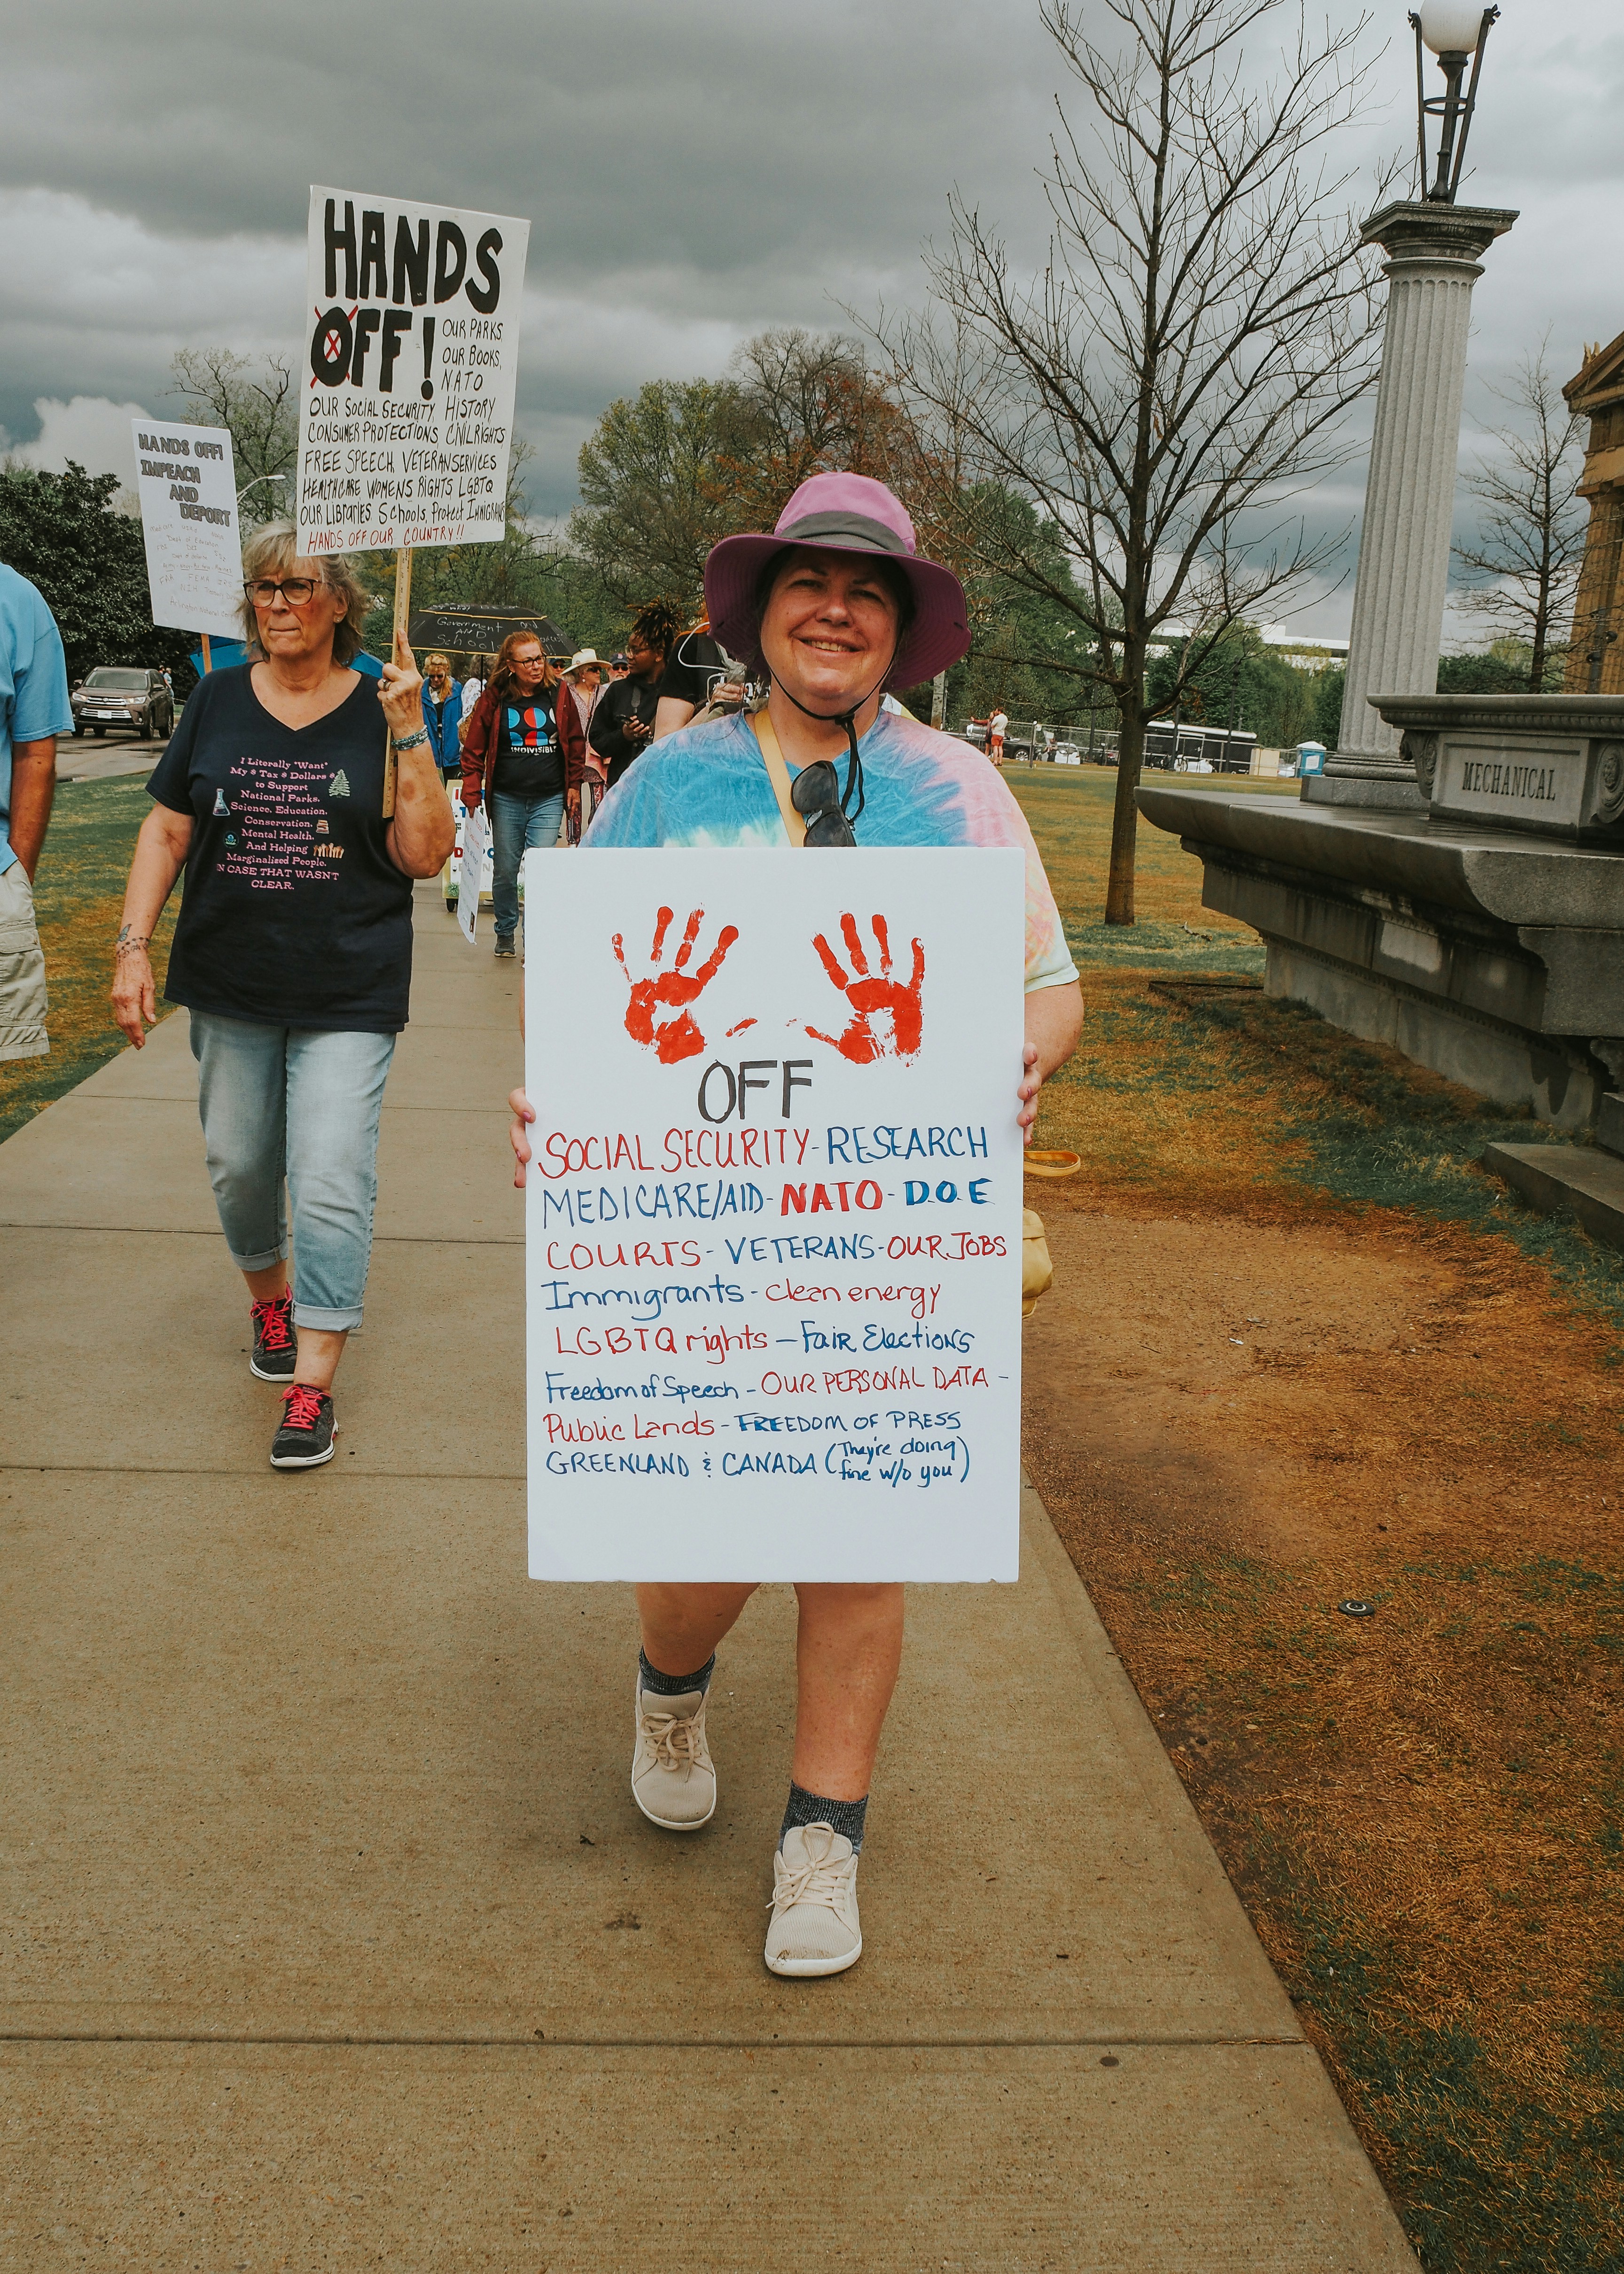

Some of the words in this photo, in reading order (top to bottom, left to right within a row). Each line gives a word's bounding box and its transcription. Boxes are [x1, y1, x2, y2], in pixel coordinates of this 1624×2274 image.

[325, 198, 503, 314] HANDS
[443, 319, 466, 339] OUR
[443, 347, 464, 366] OUR
[310, 396, 338, 417] OUR
[345, 397, 378, 417] SOCIAL
[308, 421, 359, 443] CONSUMER
[139, 433, 189, 455] HANDS
[194, 441, 224, 460] OFF!
[141, 460, 201, 483] IMPEACH
[305, 450, 341, 475] FREE
[170, 485, 198, 502] AND
[367, 478, 413, 500] WOMENS
[459, 476, 493, 498] LGBTQ
[180, 503, 230, 527] DEPORT
[300, 503, 322, 526] OUR
[431, 500, 464, 524] Protect
[308, 530, 344, 554] HANDS
[349, 529, 367, 547] OFF
[370, 527, 393, 545] OUR
[404, 525, 464, 545] COUNTRY!!
[188, 573, 209, 582] FEMA
[218, 579, 232, 588] IRS
[230, 767, 248, 776] My
[259, 769, 279, 778] Tax
[247, 757, 291, 770] Literally
[267, 780, 308, 792] Support
[1462, 761, 1556, 801] MECHANICAL
[240, 789, 285, 802] National
[241, 828, 276, 839] Mental
[246, 841, 266, 851] And
[270, 843, 308, 855] Helping
[227, 865, 258, 876] CASE
[260, 868, 292, 877] THAT
[251, 879, 295, 890] CLEAR.
[698, 1059, 813, 1124] OFF
[538, 1132, 654, 1179] SOCIAL
[828, 1126, 988, 1164] RESEARCH
[781, 1179, 883, 1216] NATO
[887, 1235, 947, 1260] OUR
[946, 1231, 1007, 1260] JOBS
[848, 1283, 940, 1319] energy
[556, 1326, 678, 1356] LGBTQ
[686, 1325, 768, 1364] rights
[546, 1371, 637, 1404] Freedom
[641, 1373, 659, 1398] of
[761, 1371, 817, 1395] OUR
[822, 1365, 925, 1394] PERSONAL
[932, 1365, 989, 1390] DATA
[543, 1413, 625, 1443] Public
[734, 1412, 848, 1432] FREEDOM
[853, 1413, 879, 1430] OF
[886, 1411, 961, 1430] PRESS
[546, 1451, 689, 1477] GREENLAND
[722, 1451, 817, 1476] CANADA
[839, 1459, 871, 1481] fine
[880, 1458, 911, 1488] w/o
